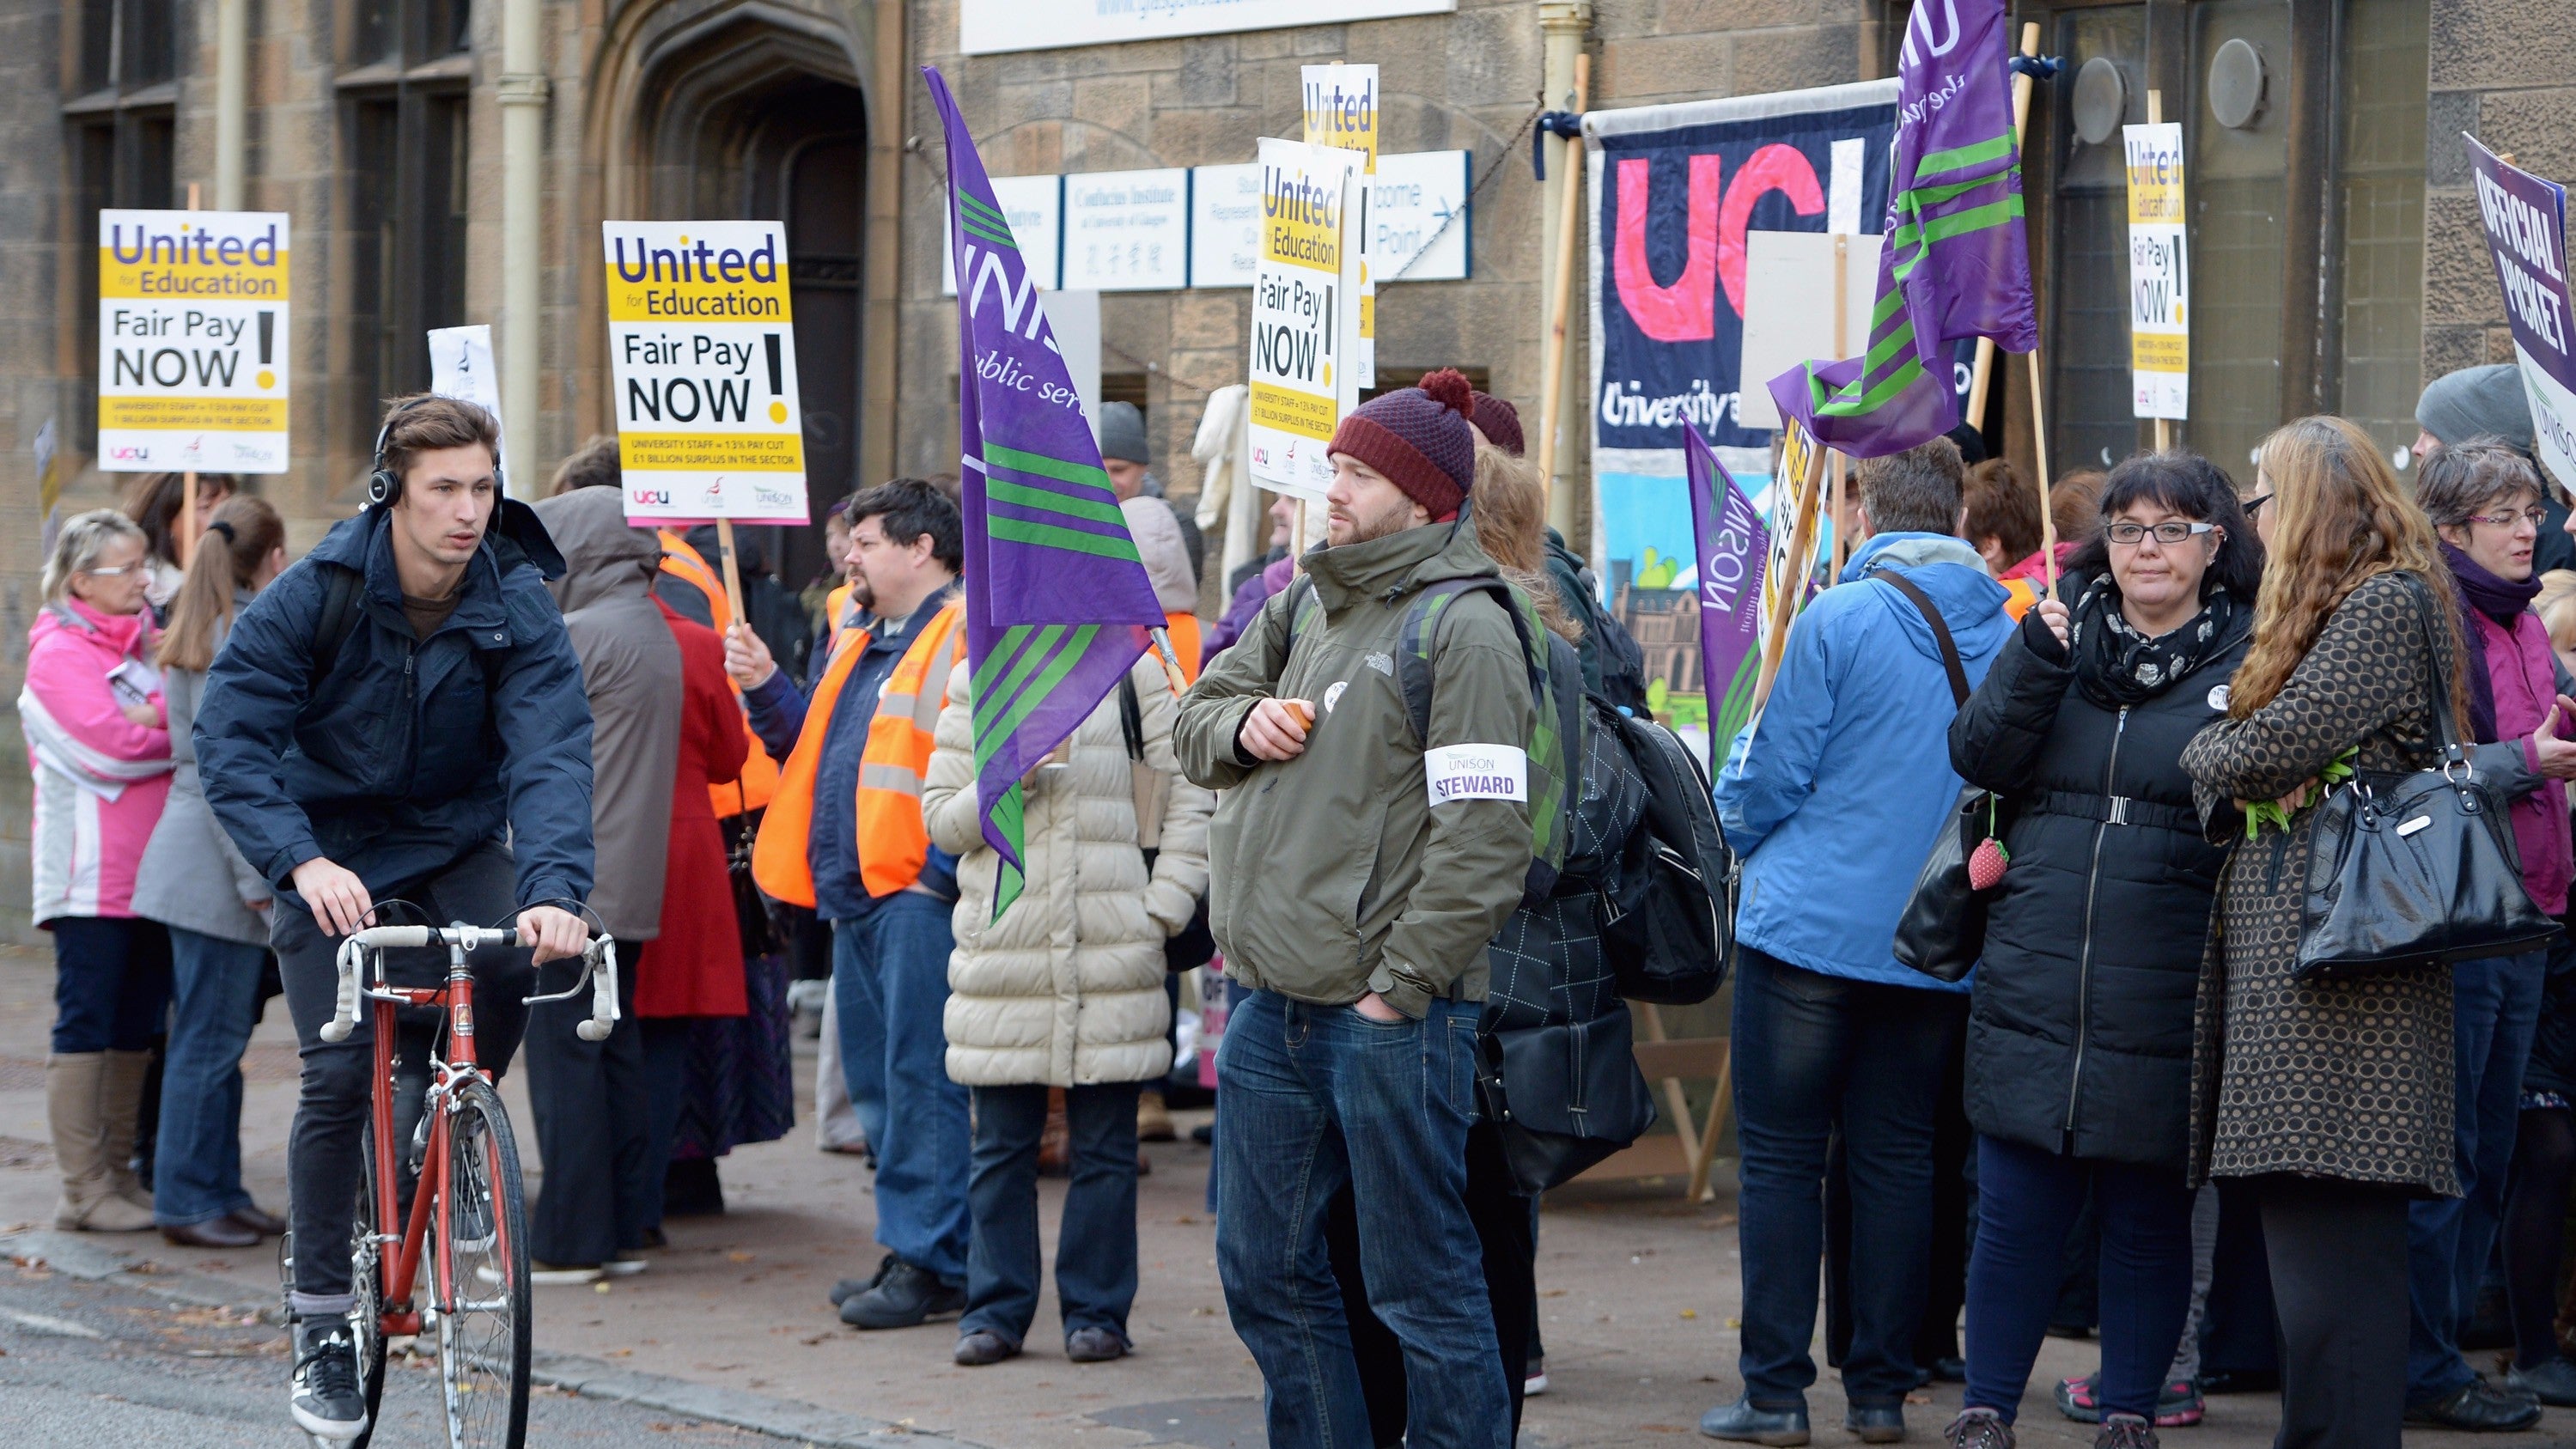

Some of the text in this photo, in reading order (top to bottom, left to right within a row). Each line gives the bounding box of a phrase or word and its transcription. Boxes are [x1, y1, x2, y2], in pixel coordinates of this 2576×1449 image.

[1264, 165, 1336, 228] United
[1375, 184, 1422, 207] come
[113, 223, 276, 266] United
[2476, 167, 2562, 284] OFFICIAL
[615, 234, 777, 283] United
[1273, 226, 1335, 265] Education
[2147, 236, 2169, 277] Pay
[141, 270, 277, 295] Education
[626, 289, 780, 315] for Education
[1259, 273, 1289, 311] Fair
[1294, 280, 1322, 329] Pay
[2134, 278, 2169, 323] NOW
[2497, 248, 2567, 356] PICKET
[114, 308, 245, 345] Fair Pay
[114, 348, 240, 387] NOW
[624, 333, 753, 374] Fair Pay
[1256, 321, 1318, 382] NOW
[628, 377, 751, 423] NOW
[1255, 391, 1280, 405] UNIVERSITY
[1281, 396, 1294, 406] STAFF
[1319, 405, 1328, 416] CUT
[1261, 408, 1278, 421] BILLION
[1278, 412, 1300, 426] SURPLUS
[1305, 418, 1314, 429] THE
[631, 440, 684, 449] UNIVERSITY
[687, 440, 713, 449] STAFF
[725, 441, 745, 450] 13%
[747, 441, 763, 450] PAY
[766, 441, 784, 450] CUT
[633, 454, 795, 466] £1 BILLION SURPLUS IN THE SECTOR
[634, 490, 668, 504] ucu
[1449, 758, 1495, 770] UNISON
[1435, 776, 1514, 797] STEWARD
